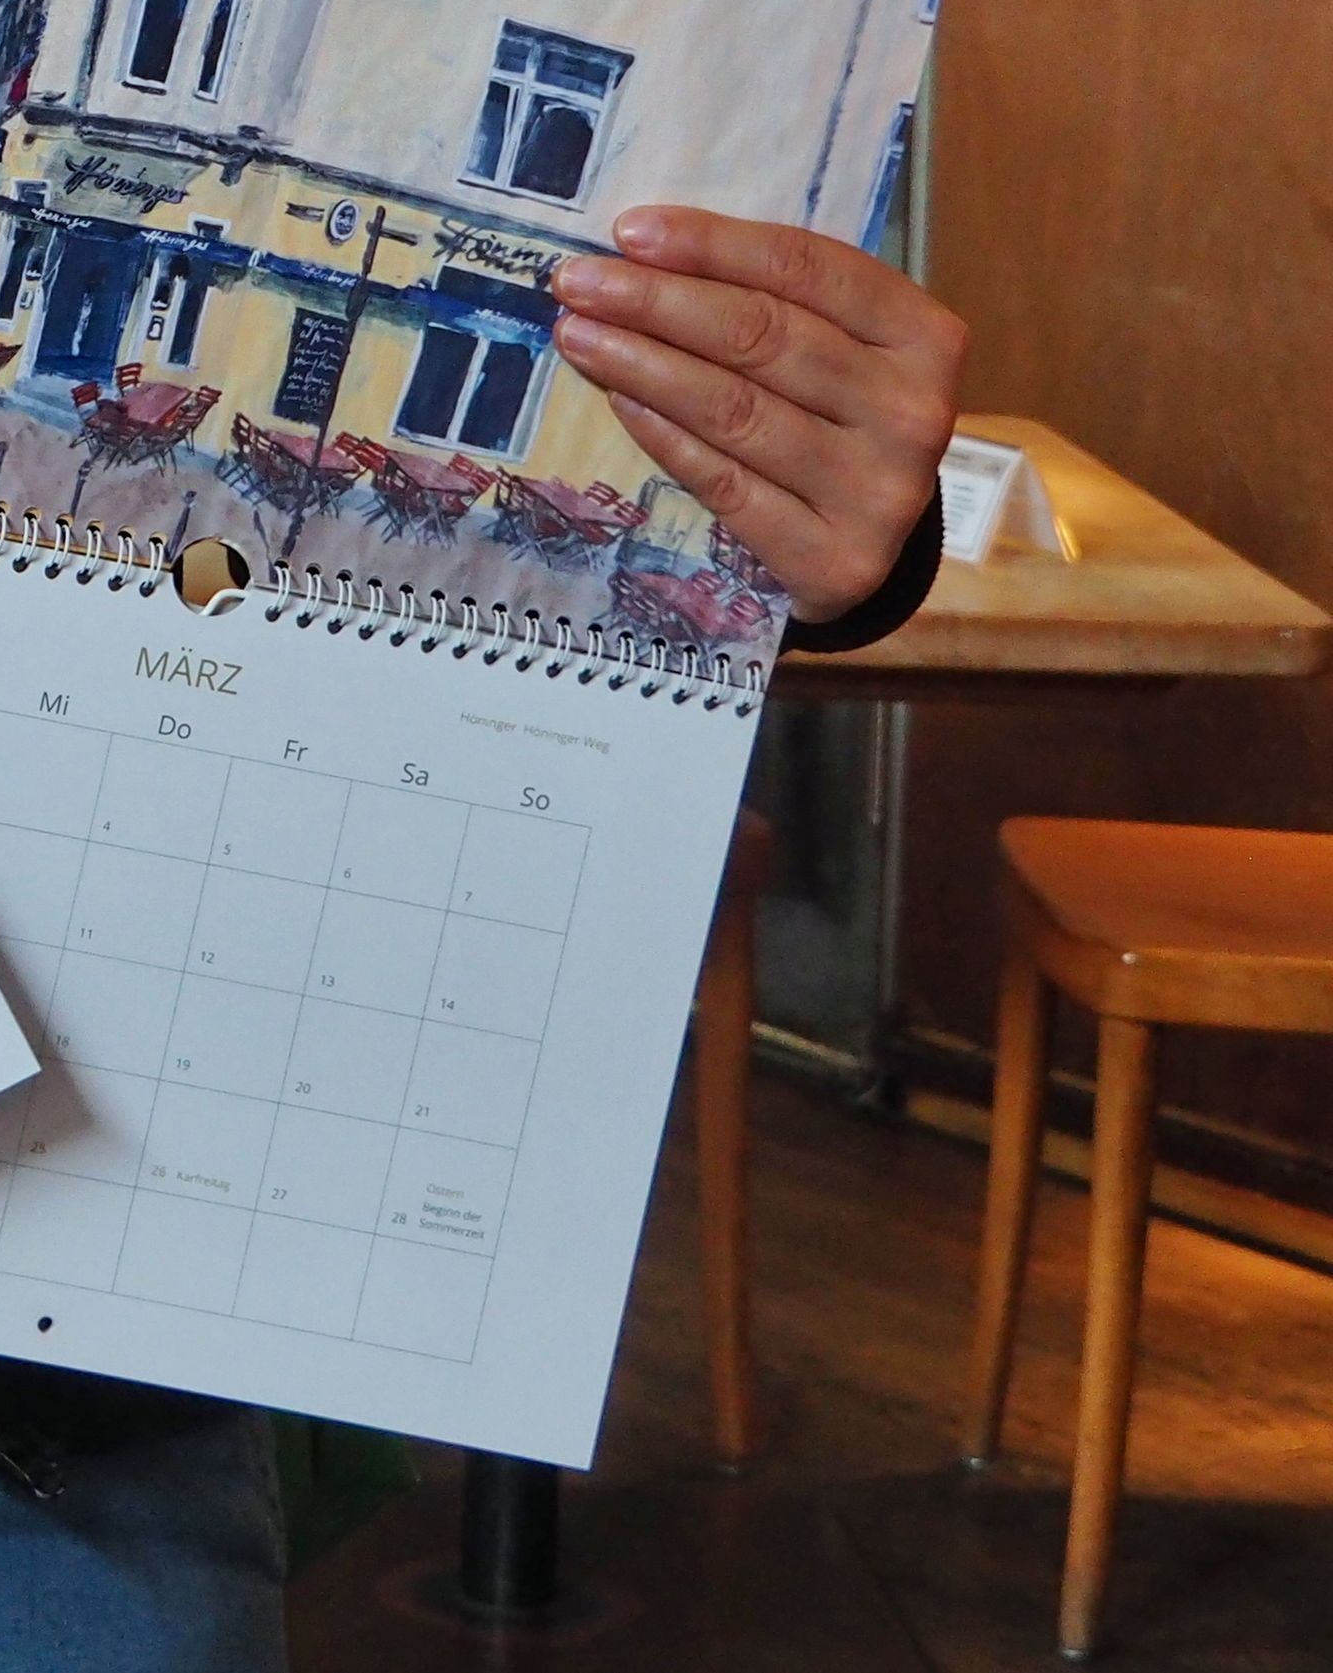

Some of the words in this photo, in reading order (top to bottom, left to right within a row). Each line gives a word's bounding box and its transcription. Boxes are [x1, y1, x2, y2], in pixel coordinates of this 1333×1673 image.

[135, 646, 244, 695] MÄRZ
[39, 691, 70, 716] Mi
[158, 714, 192, 740] Do
[283, 739, 309, 762] Fr
[400, 762, 429, 787] Sa
[519, 786, 550, 811] So
[102, 821, 111, 831] 4
[224, 844, 231, 856] 5
[343, 867, 352, 879] 6
[464, 890, 473, 902] 7
[80, 927, 93, 940] 11
[201, 951, 215, 965] 12
[321, 974, 336, 988] 13
[441, 998, 455, 1011] 14
[176, 1058, 191, 1071] 19
[294, 1080, 312, 1095] 20
[414, 1104, 430, 1117] 21
[271, 1188, 287, 1201] 27
[391, 1212, 407, 1225] 28
